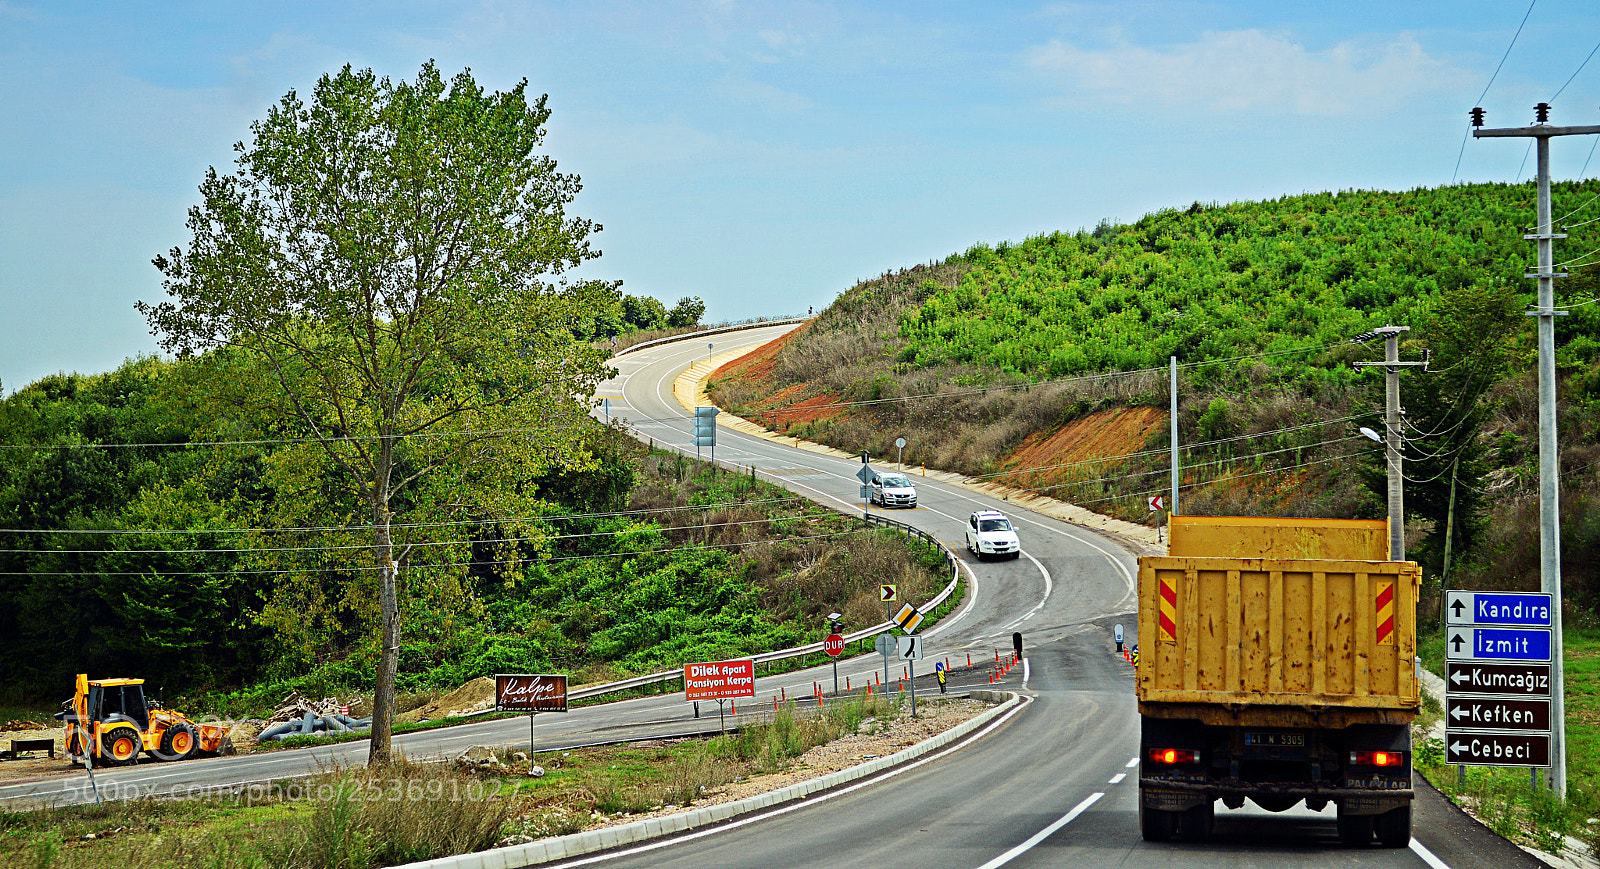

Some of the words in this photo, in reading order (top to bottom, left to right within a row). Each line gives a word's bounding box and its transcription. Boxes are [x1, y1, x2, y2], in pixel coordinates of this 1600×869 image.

[1479, 600, 1548, 619] Kandıra
[825, 639, 843, 651] DUR
[1478, 630, 1528, 653] İzmit
[690, 664, 720, 678] Dilek
[721, 665, 746, 676] Apart
[1472, 668, 1548, 692] Kumcağız
[501, 676, 555, 703] Kalpe
[686, 678, 725, 689] Pansiyon
[726, 676, 752, 687] Kerpe
[1472, 704, 1534, 724] Kefken
[1251, 734, 1261, 744] 41
[1281, 735, 1303, 745] 5305
[1471, 738, 1530, 759] Cebeci
